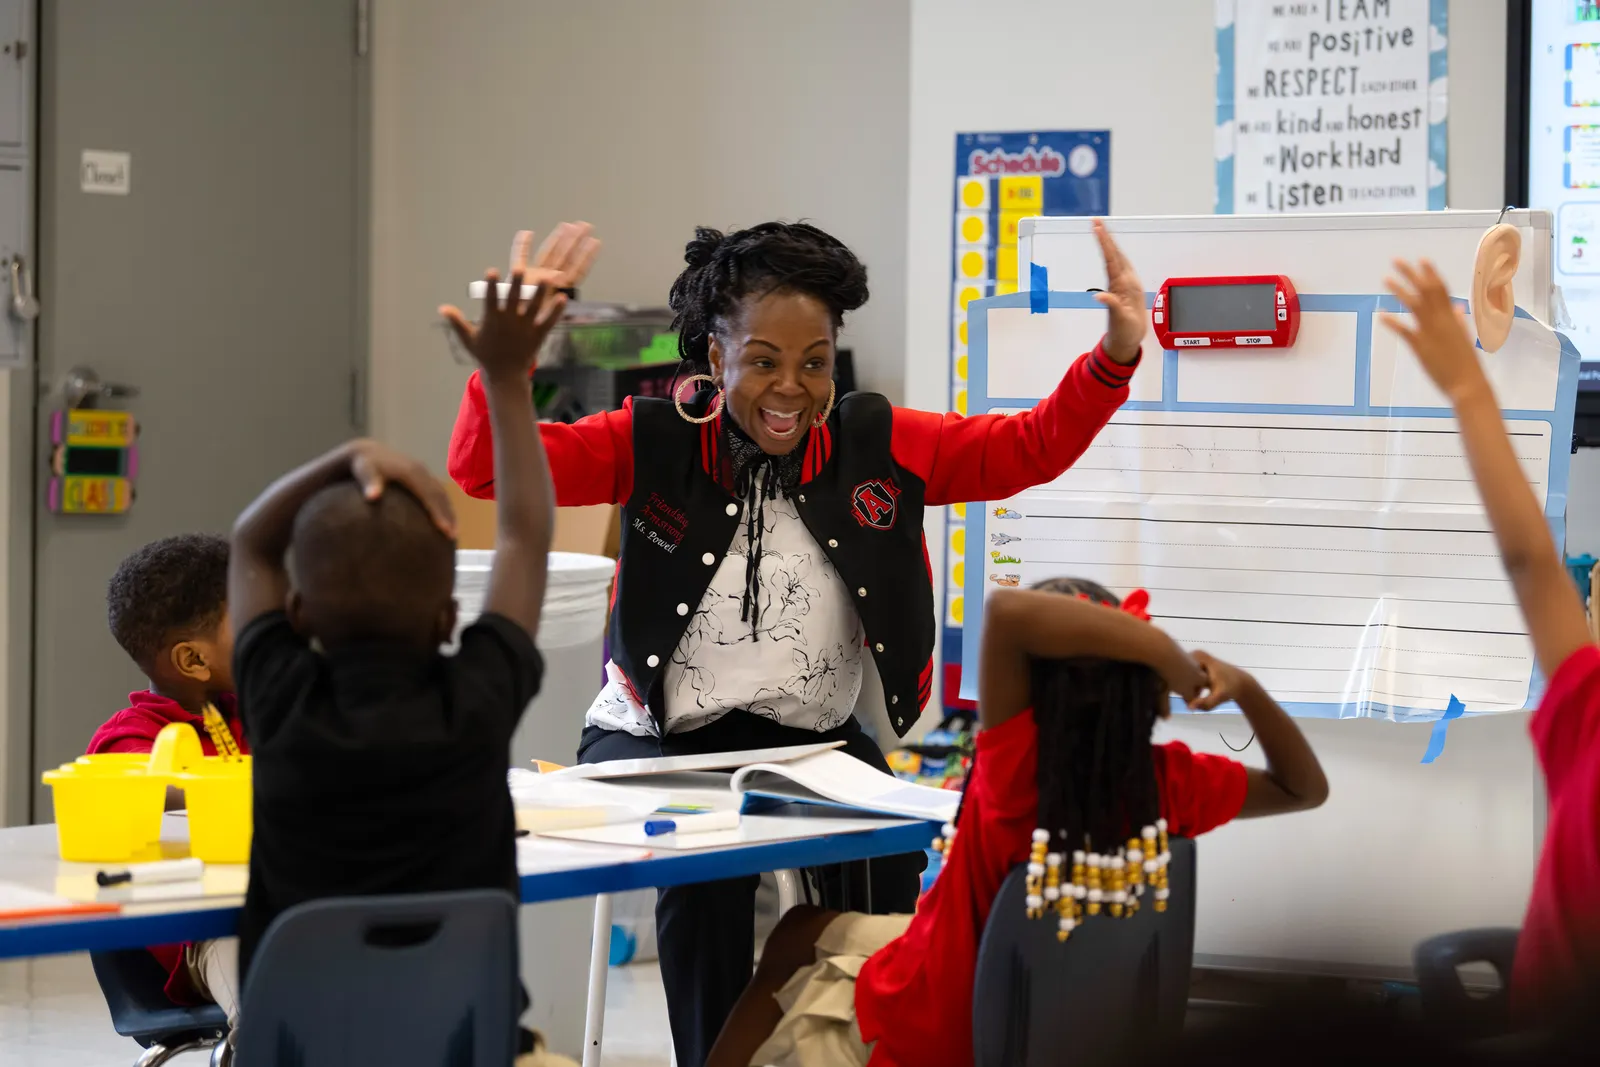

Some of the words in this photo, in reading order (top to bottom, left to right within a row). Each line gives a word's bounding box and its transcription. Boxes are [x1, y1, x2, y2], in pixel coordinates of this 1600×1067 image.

[1326, 0, 1391, 22] TEAM
[1308, 26, 1414, 61] positive
[1264, 66, 1359, 98] RESPECT
[1276, 106, 1322, 135] kind
[1347, 104, 1422, 131] honest
[972, 152, 1061, 175] Schedule
[1280, 140, 1343, 173] Work
[1347, 138, 1401, 168] Hard
[1266, 181, 1343, 212] Listen
[857, 486, 894, 524] A
[632, 517, 646, 534] Ms.
[646, 530, 678, 554] Powell
[640, 505, 685, 546] Armstrong
